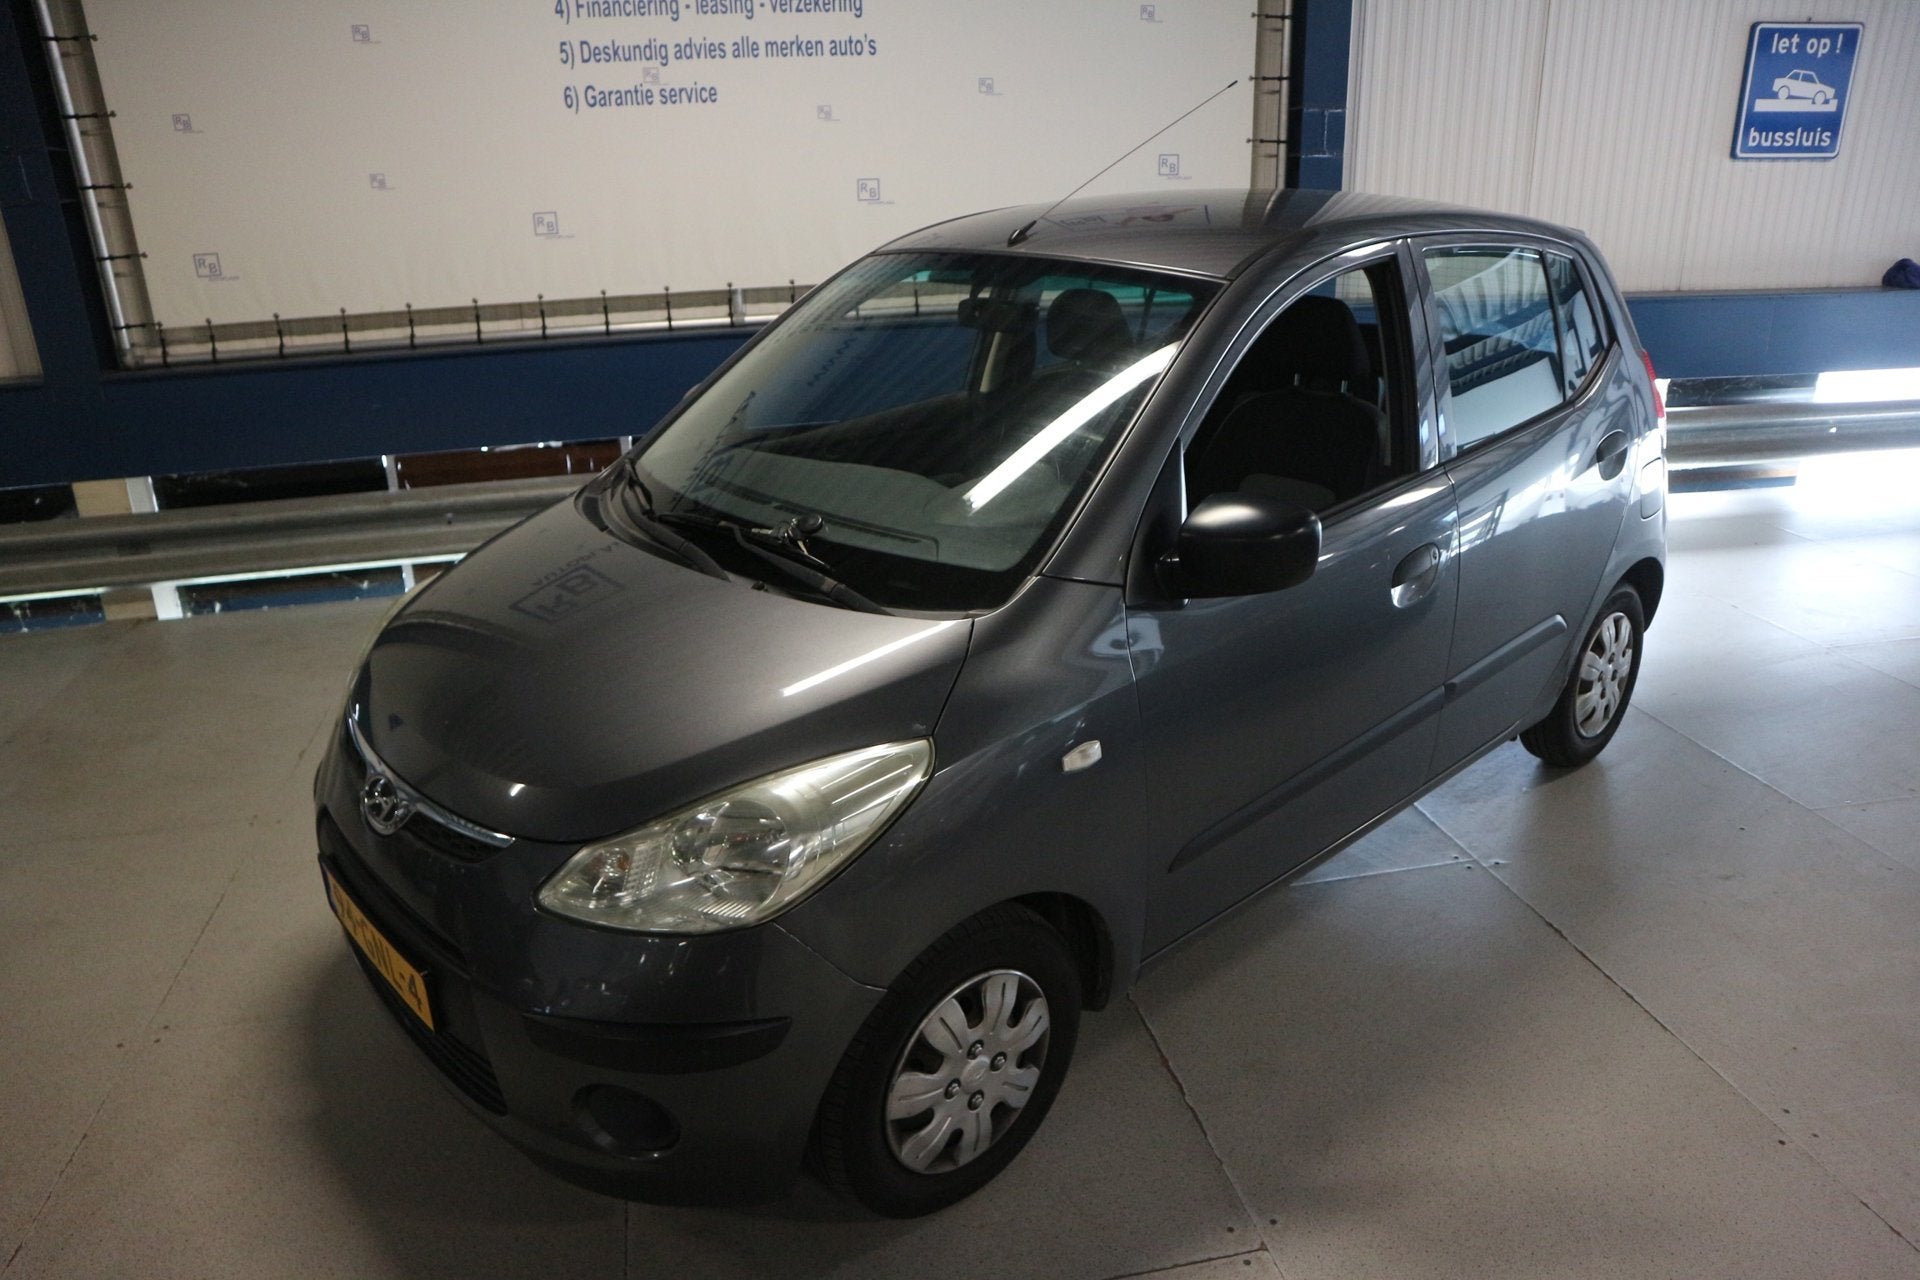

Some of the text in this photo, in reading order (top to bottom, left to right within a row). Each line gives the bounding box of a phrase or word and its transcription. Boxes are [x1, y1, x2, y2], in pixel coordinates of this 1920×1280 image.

[555, 0, 570, 24] 4)
[576, 0, 680, 21] Financiering
[696, 0, 754, 19] leasing
[770, 0, 863, 18] verzekering
[560, 33, 877, 69] 5) Deskundig advies alle merken auto's
[1771, 33, 1800, 54] let
[1806, 37, 1831, 58] op
[564, 81, 718, 114] 6) Garantie service
[1748, 127, 1832, 147] bussluis
